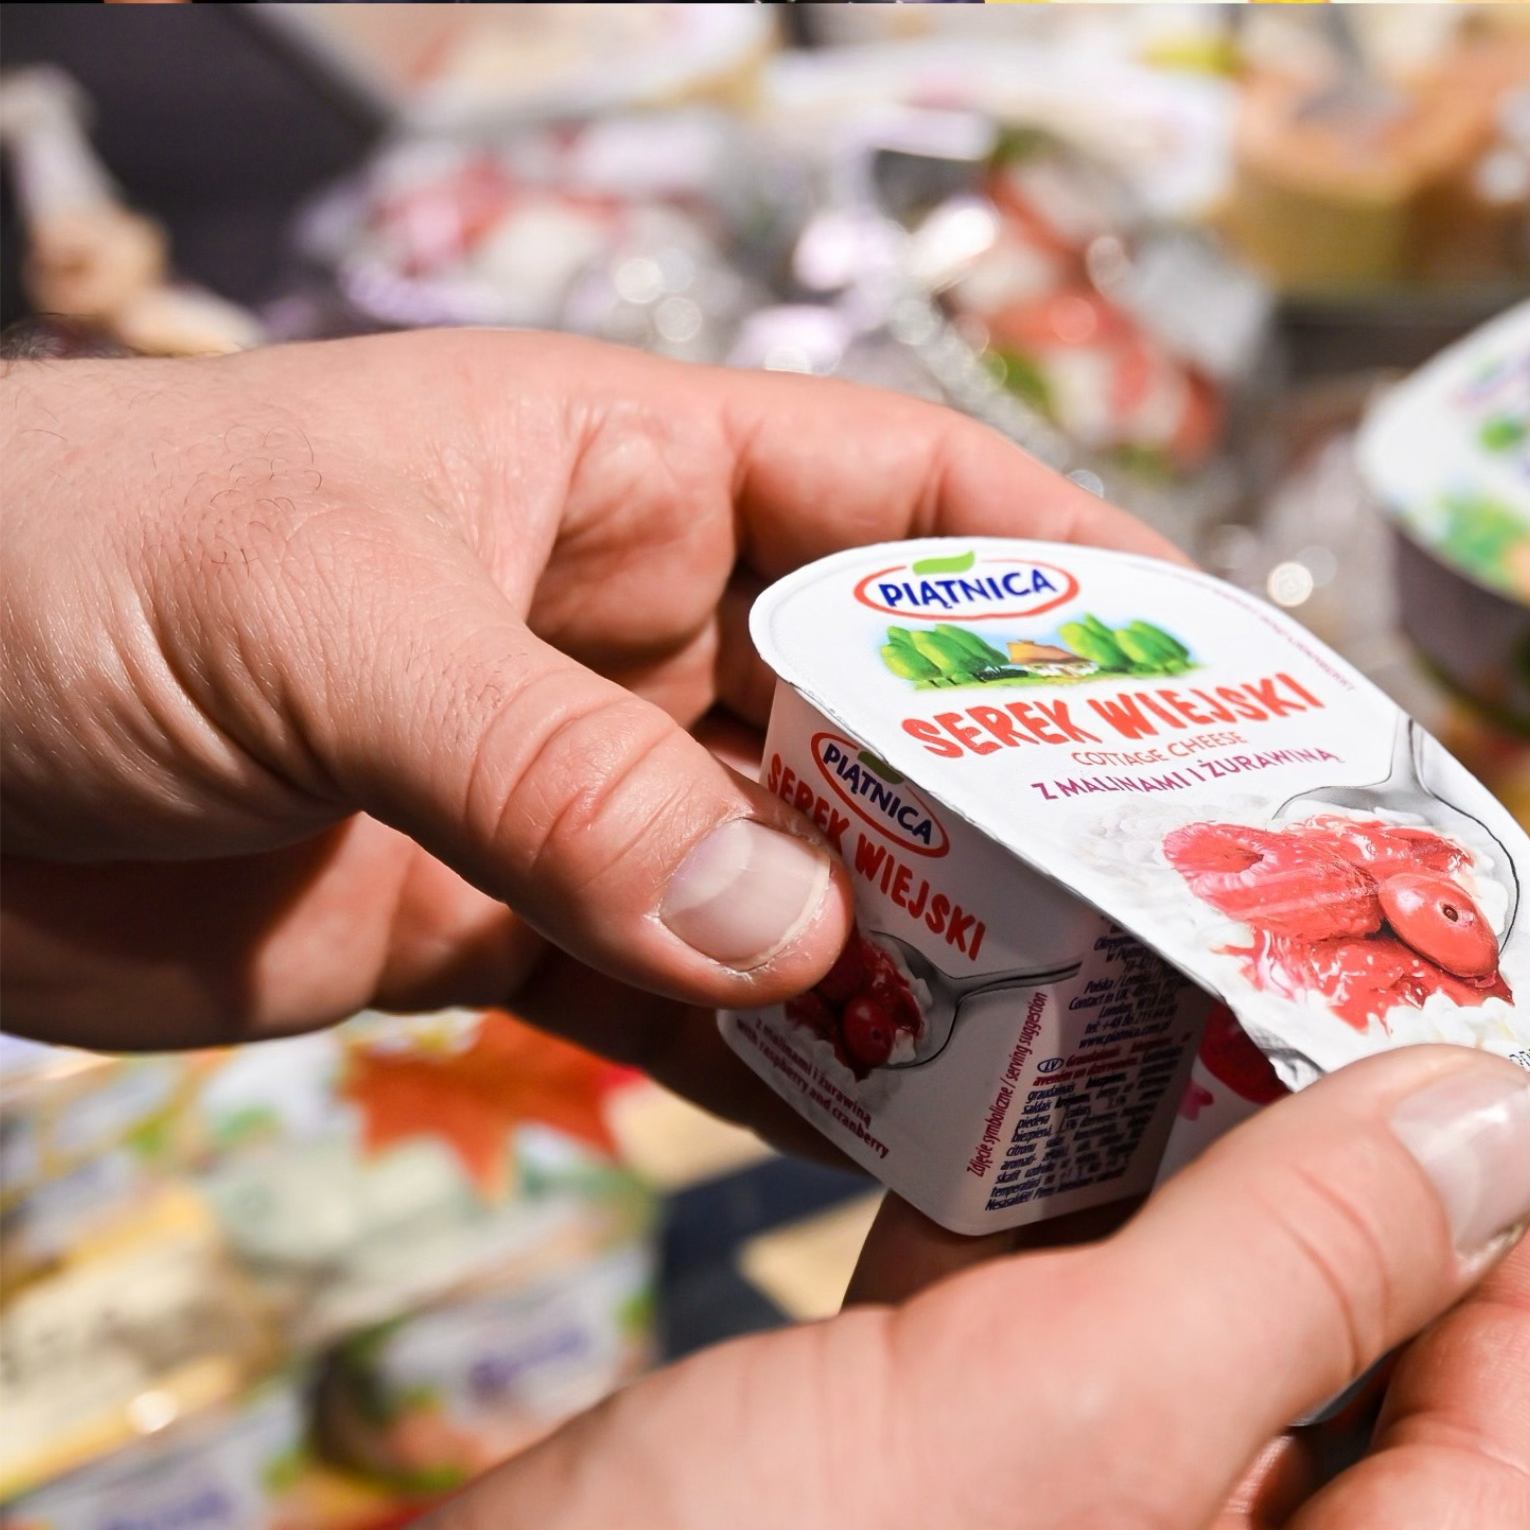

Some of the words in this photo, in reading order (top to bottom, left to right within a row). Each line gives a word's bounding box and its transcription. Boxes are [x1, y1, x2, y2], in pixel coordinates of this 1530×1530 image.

[879, 569, 1056, 611] PIĄTNICA
[902, 698, 1103, 758] SEREK
[1097, 672, 1325, 741] WIEJSKI
[1031, 781, 1056, 801] Z
[1057, 767, 1188, 798] MALINAMI
[1198, 746, 1346, 780] ŻURAWINĄ
[1072, 745, 1167, 767] COTTAGE
[1168, 729, 1247, 760] CHEESE
[823, 742, 932, 845] PIĄTNICA
[854, 831, 986, 962] WIEJSKI
[1019, 992, 1048, 1046] suggestion
[1006, 1046, 1033, 1081] serving
[759, 1041, 809, 1093] raspberry
[810, 1087, 832, 1112] and
[832, 1106, 889, 1160] cranberry
